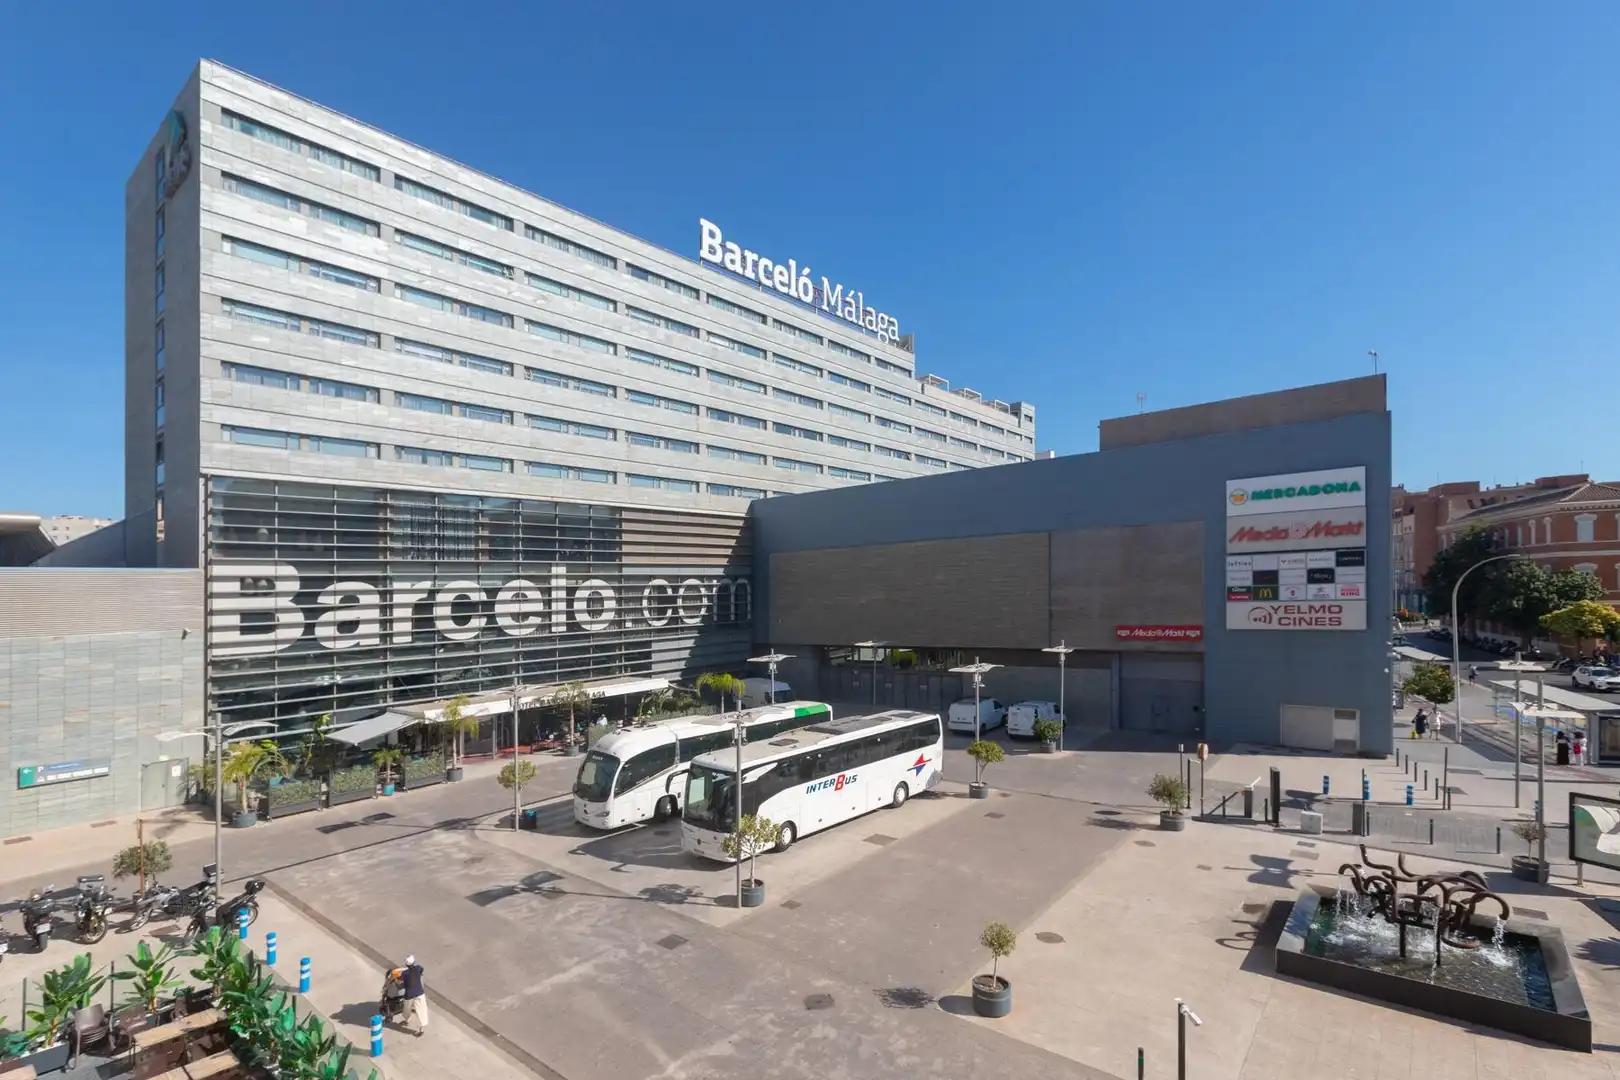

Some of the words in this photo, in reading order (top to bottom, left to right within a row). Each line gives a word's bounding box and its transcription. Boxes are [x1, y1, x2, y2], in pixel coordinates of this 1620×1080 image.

[700, 217, 814, 304] Barceló
[821, 276, 900, 345] Málaga
[1251, 481, 1361, 501] MERCADONA
[211, 560, 752, 656] Barcelo.com
[1270, 604, 1343, 615] YELMO
[1277, 616, 1343, 626] CINES
[806, 774, 858, 795] INTERBUS
